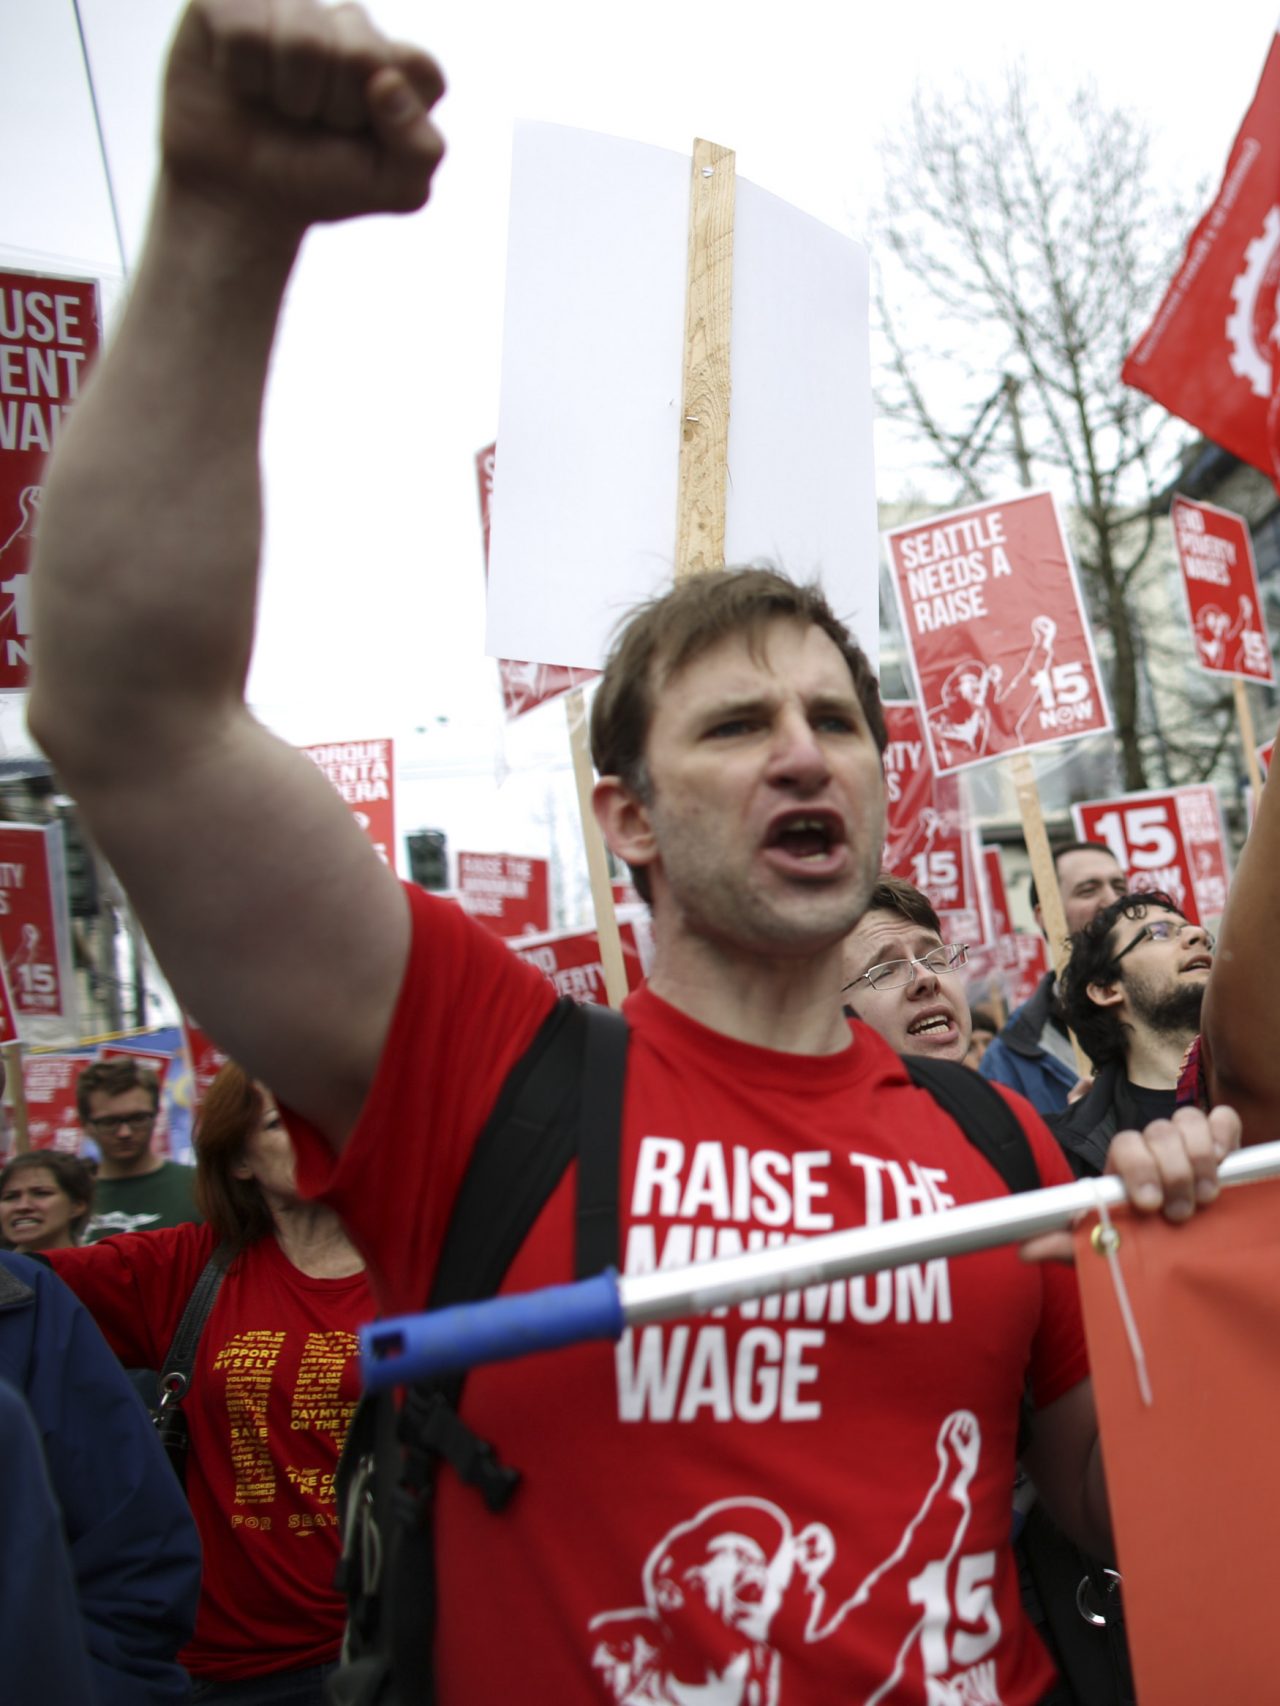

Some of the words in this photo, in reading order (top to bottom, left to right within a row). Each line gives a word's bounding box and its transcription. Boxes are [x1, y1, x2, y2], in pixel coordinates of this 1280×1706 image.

[900, 511, 1007, 569] SEATTLE
[907, 551, 987, 601] NEEDS
[992, 546, 1012, 578] A
[913, 585, 988, 634] RAISE
[1030, 662, 1090, 709] 15
[1039, 702, 1093, 730] NOW
[1094, 806, 1177, 871] 15
[911, 852, 957, 888] 15
[17, 963, 56, 993] 15
[630, 1136, 833, 1229] RAISE
[849, 1152, 955, 1221] THE
[213, 1358, 277, 1370] MYSELF
[217, 1348, 280, 1360] SUPPORT
[615, 1326, 826, 1423] WAGE
[290, 1420, 310, 1430] ON
[314, 1420, 341, 1430] THE
[291, 1409, 319, 1419] PAY
[319, 1409, 340, 1419] MY
[231, 1515, 272, 1531] FOR
[907, 1550, 1000, 1675] 15
